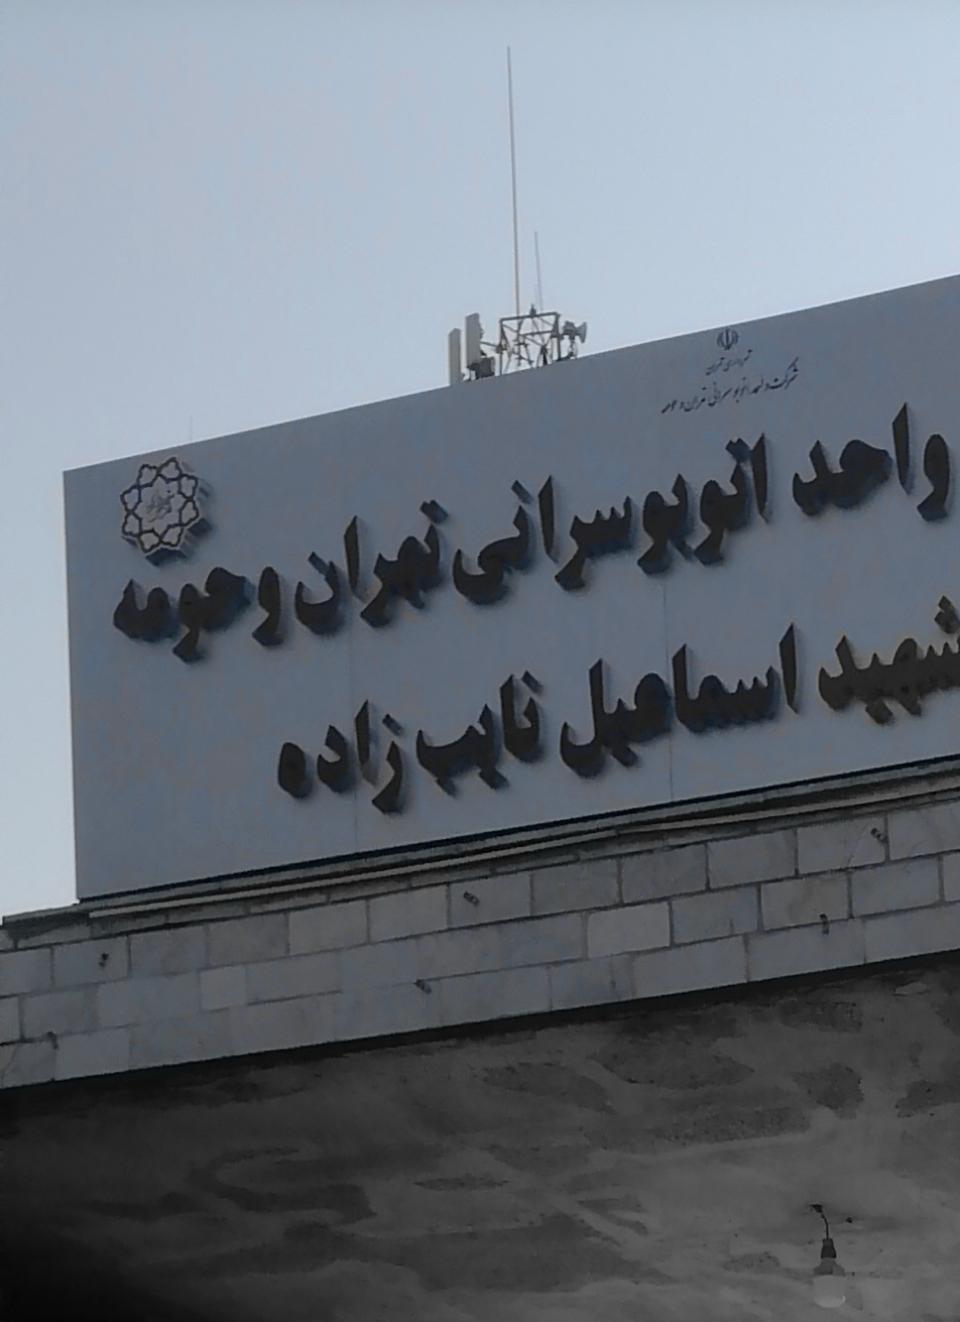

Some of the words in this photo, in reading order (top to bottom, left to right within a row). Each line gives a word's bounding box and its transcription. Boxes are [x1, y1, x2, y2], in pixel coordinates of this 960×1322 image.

[452, 433, 770, 598] اتوبوسرانی
[792, 402, 951, 520] واحد
[112, 566, 251, 662] حومه
[252, 566, 282, 648] و
[296, 500, 448, 637] تهران
[277, 699, 406, 815] زاده
[415, 670, 544, 796] نایب
[560, 622, 800, 778] اسماعیل
